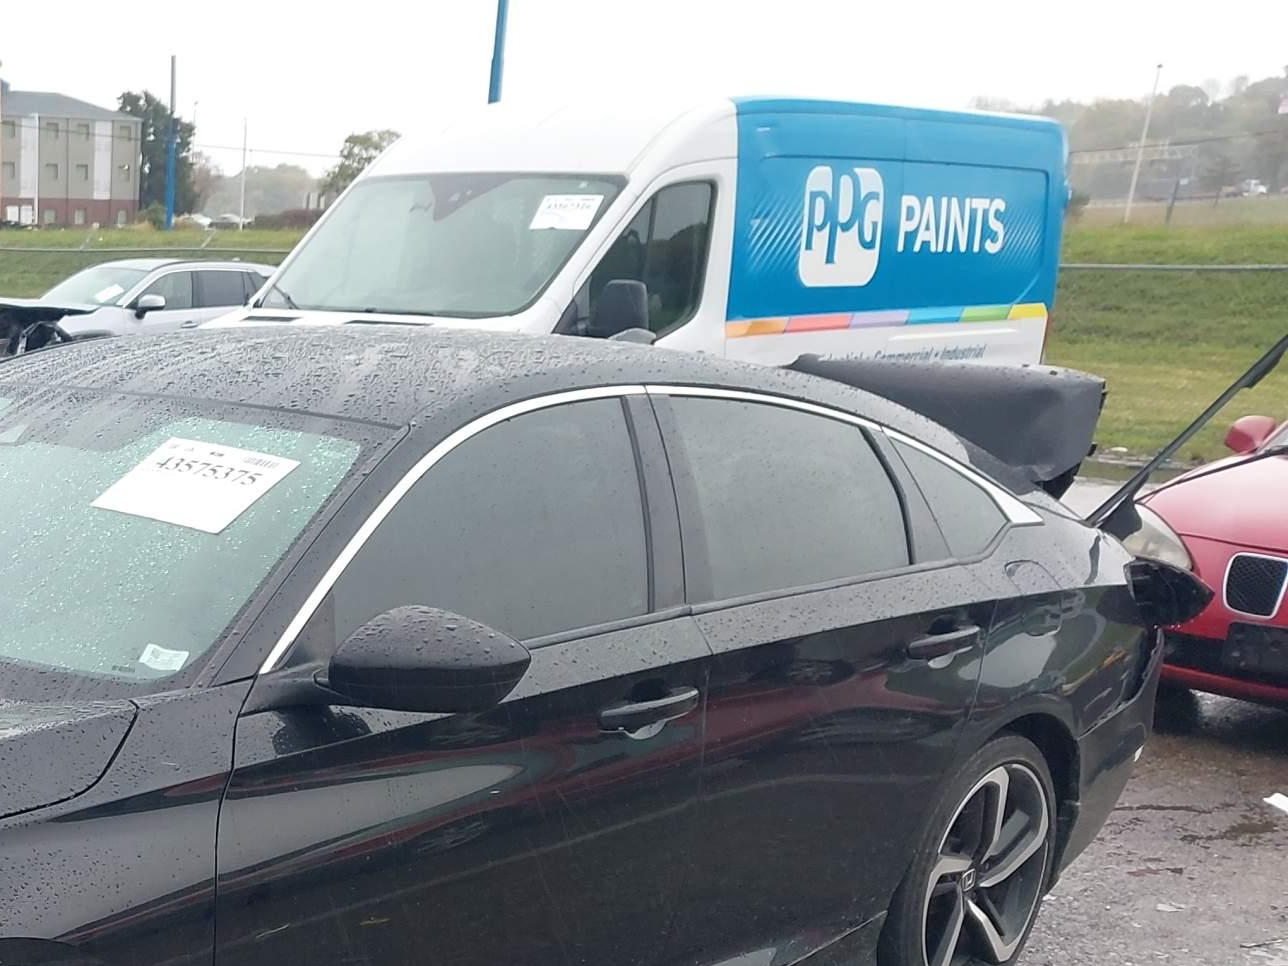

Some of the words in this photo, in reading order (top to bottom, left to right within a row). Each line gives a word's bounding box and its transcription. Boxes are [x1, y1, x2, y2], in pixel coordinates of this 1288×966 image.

[896, 195, 1006, 254] PAINTS
[940, 344, 987, 360] Industrial
[156, 456, 263, 485] 43575375
